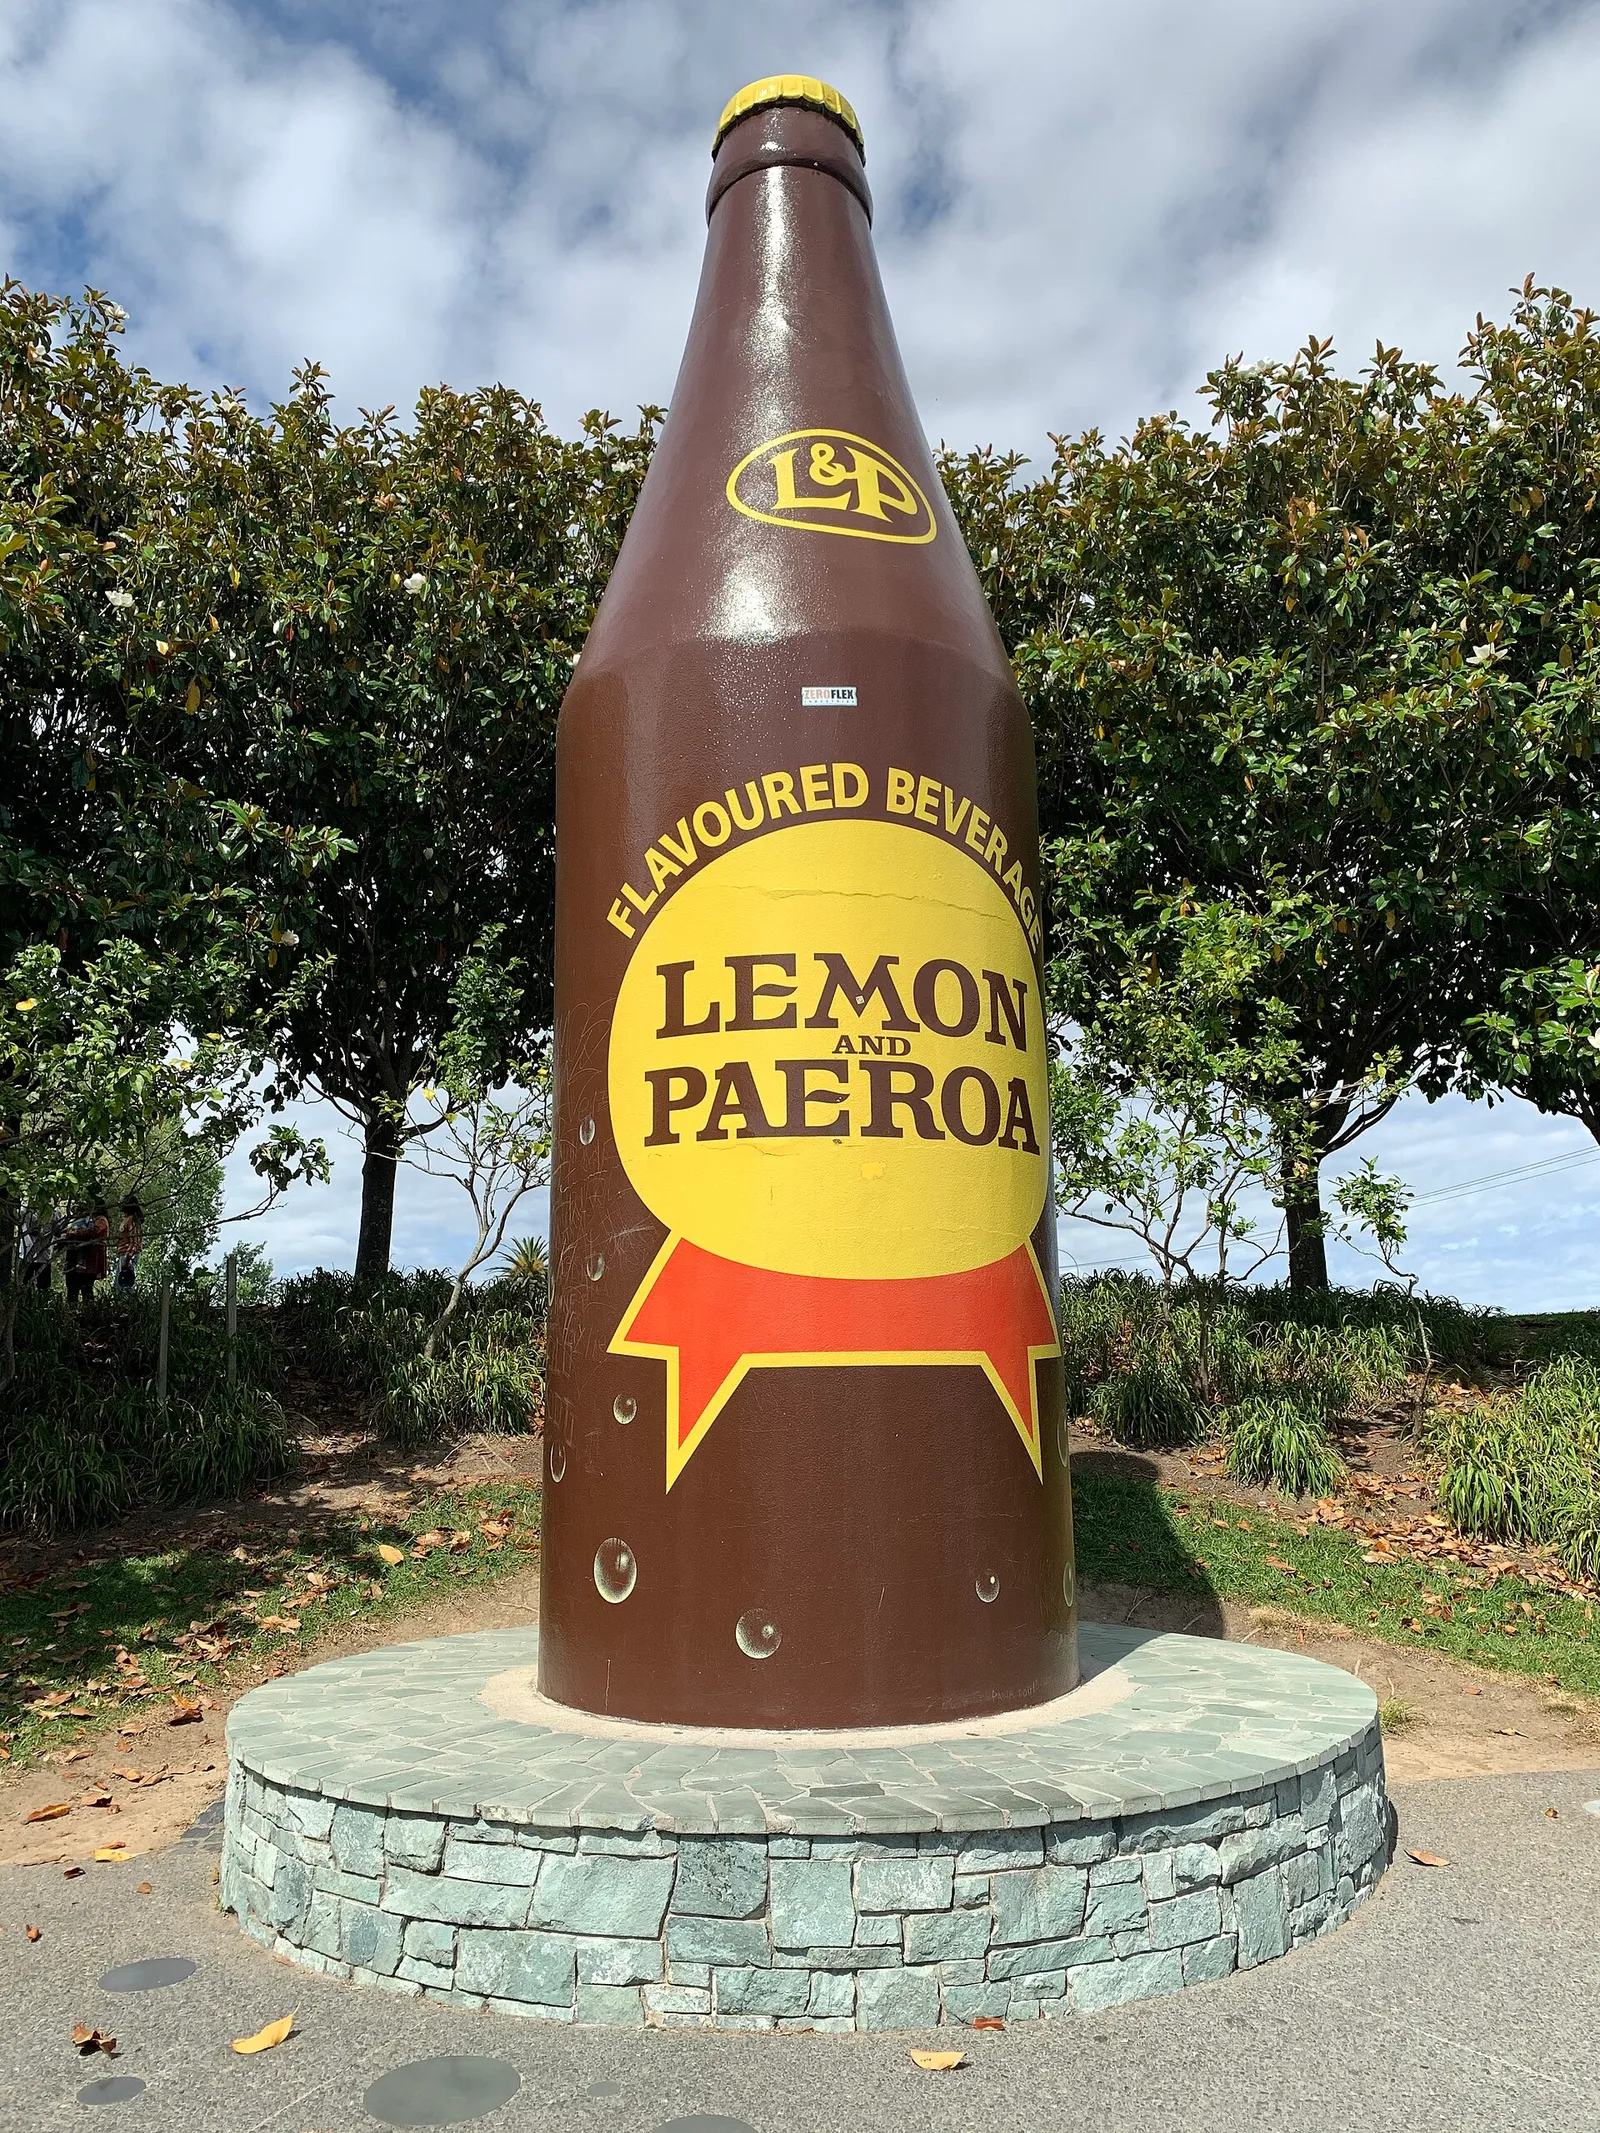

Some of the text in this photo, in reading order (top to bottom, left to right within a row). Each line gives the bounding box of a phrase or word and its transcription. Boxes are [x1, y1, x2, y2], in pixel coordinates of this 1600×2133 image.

[766, 442, 918, 523] L&P
[804, 689, 854, 699] ZEROFLEX
[606, 762, 1041, 954] FLAVOURED BEVERAGE
[656, 953, 1027, 1052] LEMON
[831, 1034, 912, 1057] AND
[644, 1059, 1041, 1156] PAEROA
